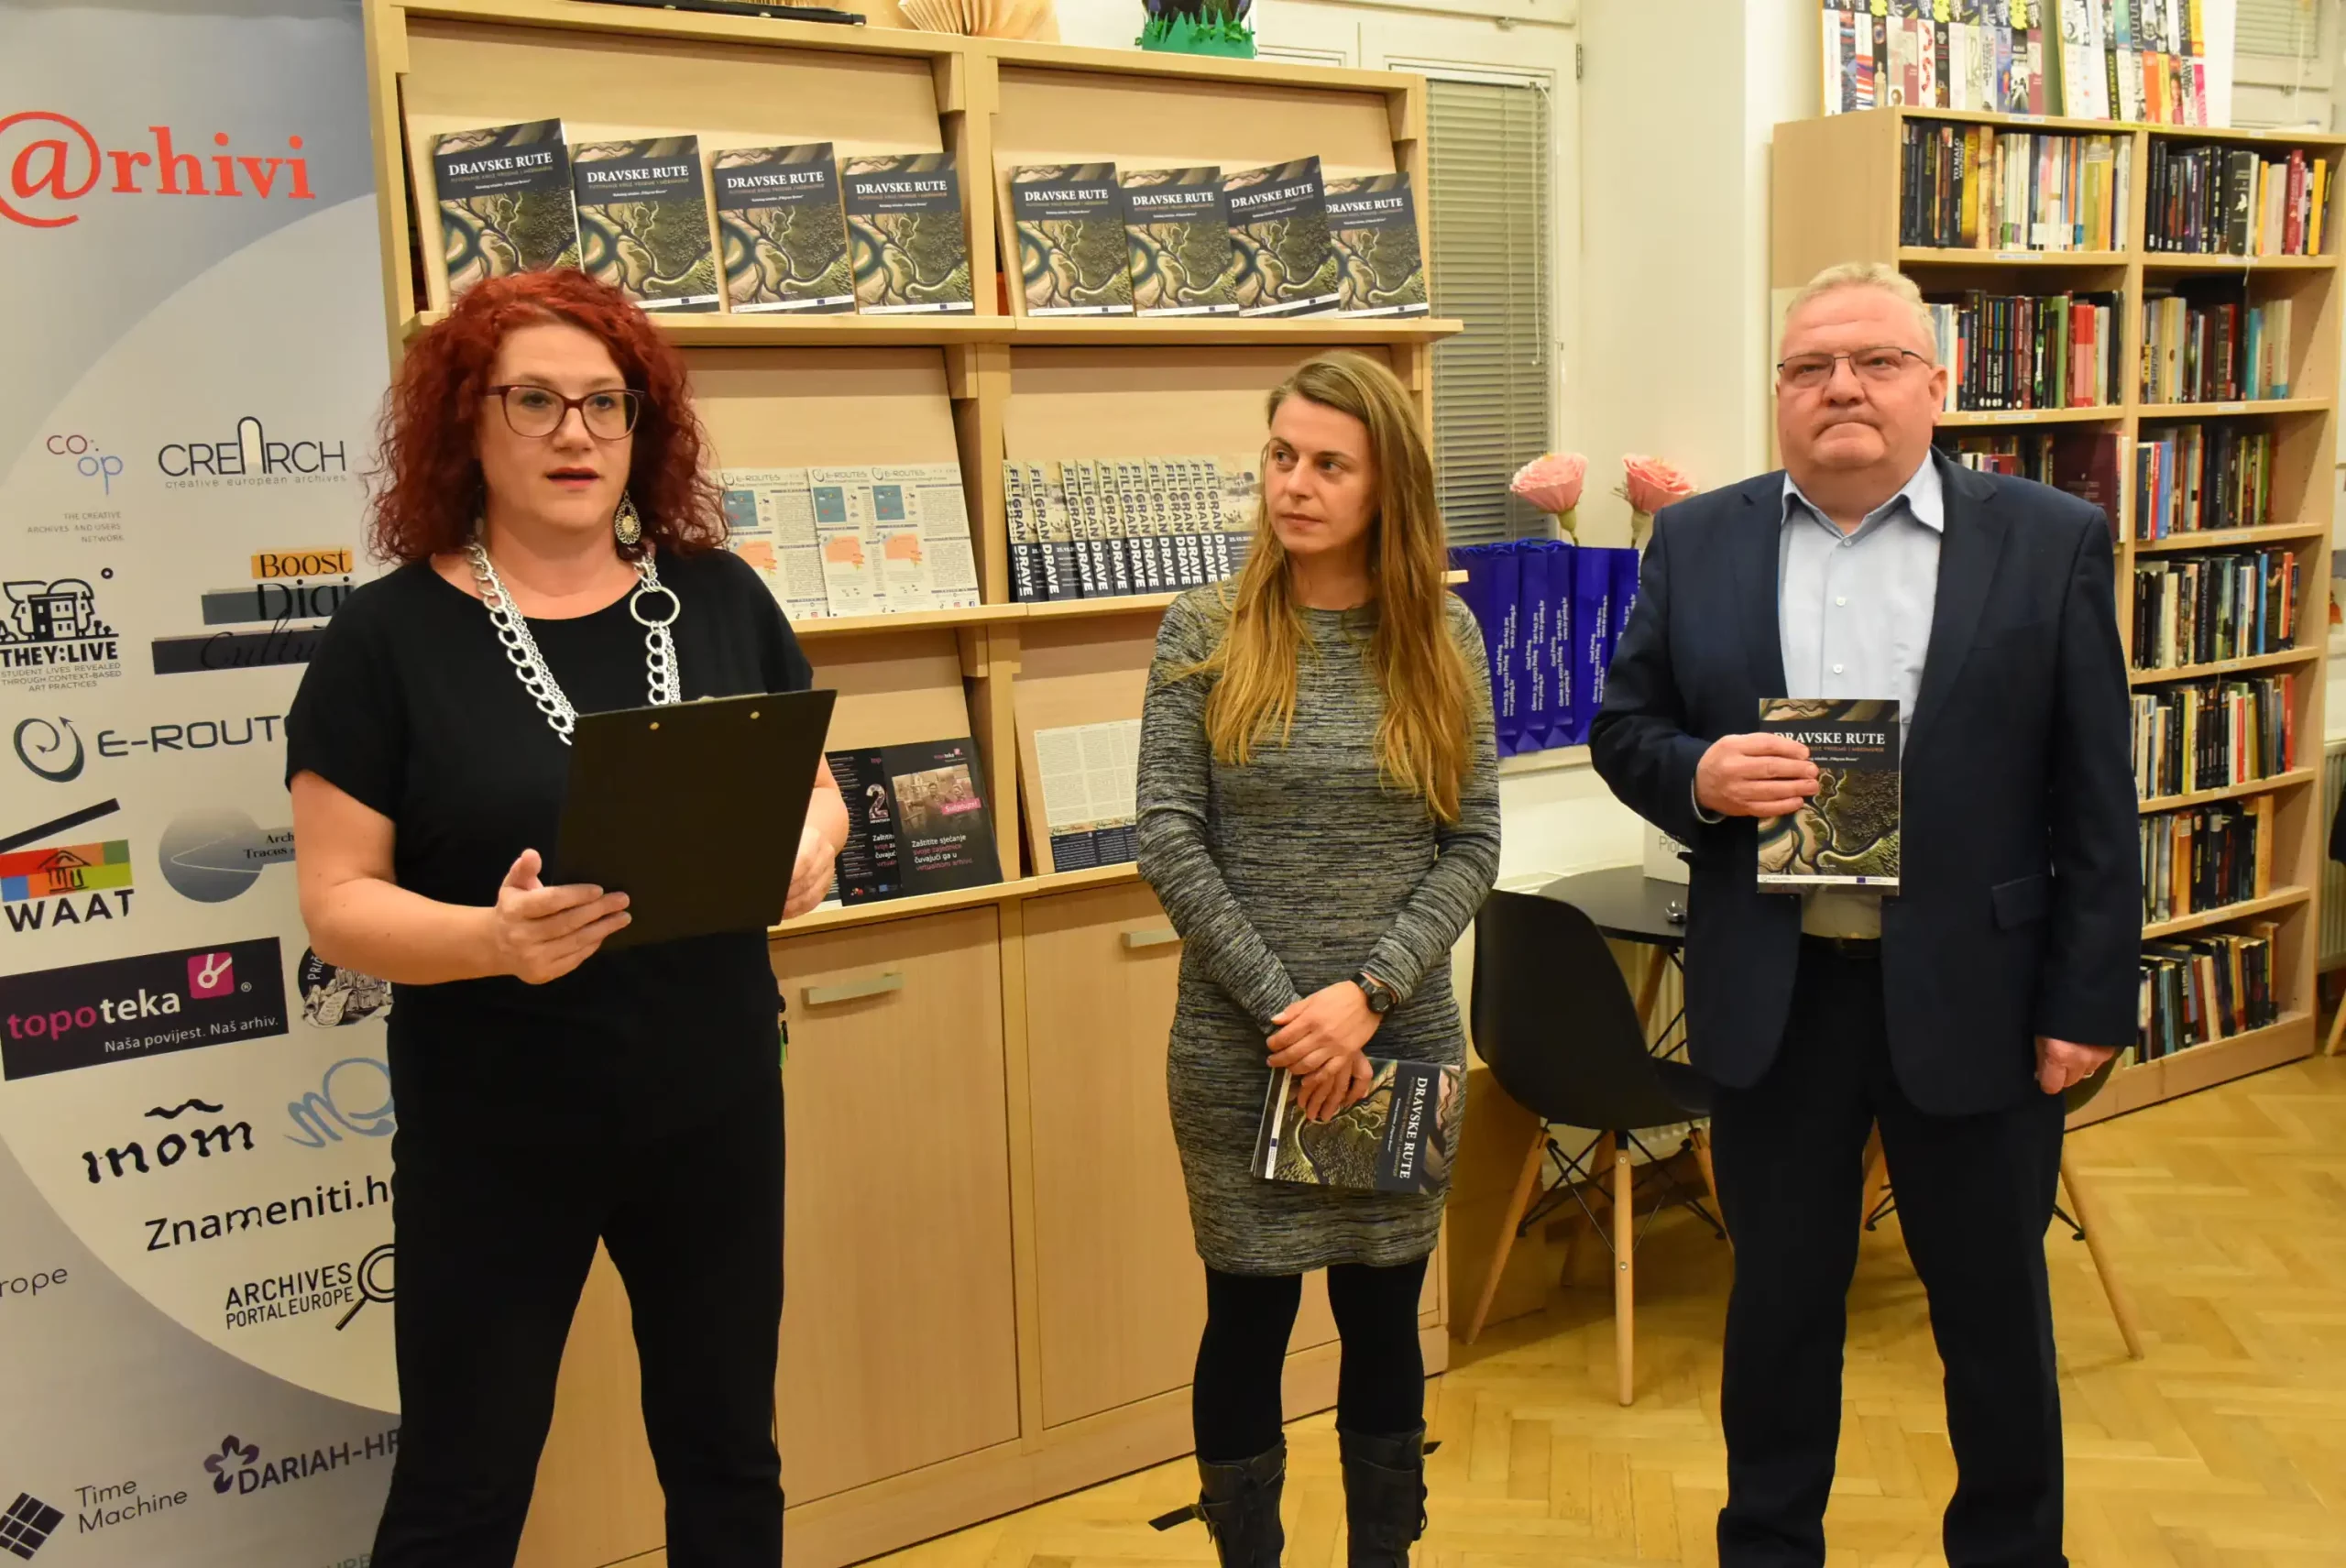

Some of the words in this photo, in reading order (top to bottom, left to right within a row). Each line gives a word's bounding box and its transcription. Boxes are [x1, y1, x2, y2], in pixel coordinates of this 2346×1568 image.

[448, 158, 513, 176] DRAVSKE
[516, 152, 553, 168] RUTE
[587, 169, 650, 182] DRAVSKE
[652, 165, 689, 178] RUTE
[727, 174, 787, 188] DRAVSKE
[789, 171, 824, 184] RUTE
[856, 181, 912, 194] DRAVSKE
[915, 181, 947, 192] RUTE
[1025, 191, 1076, 201] DRAVSKE
[1078, 189, 1109, 200] RUTE
[1133, 194, 1183, 205] DRAVSKE
[1184, 192, 1214, 203] RUTE
[1231, 190, 1283, 208] DRAVSKE
[1284, 183, 1314, 198] RUTE
[1374, 198, 1403, 209] RUTE
[166, 479, 219, 489] creative
[226, 477, 287, 487] european
[295, 474, 347, 483] archives
[64, 512, 80, 521] THE
[82, 511, 121, 520] CREATIVE
[1010, 469, 1025, 541] FILIGRAN
[1190, 464, 1210, 531] FILIGRAN
[1201, 535, 1217, 583] DRAVE
[1204, 464, 1222, 530] FILIGRAN
[1214, 534, 1231, 581] DRAVE
[27, 525, 70, 533] ARCHIVES
[81, 534, 125, 543] NETWORK
[1031, 469, 1049, 540] FILIGRAN
[1042, 544, 1059, 594] DRAVE
[1064, 468, 1083, 538] FILIGRAN
[1076, 543, 1093, 591] DRAVE
[1080, 467, 1100, 537] FILIGRAN
[1091, 542, 1108, 590] DRAVE
[1101, 467, 1119, 535] FILIGRAN
[1111, 541, 1127, 589] DRAVE
[1118, 466, 1136, 534] FILIGRAN
[1129, 539, 1146, 587] DRAVE
[1132, 466, 1150, 533] FILIGRAN
[1142, 538, 1159, 587] DRAVE
[1149, 466, 1168, 532] FILIGRAN
[1159, 537, 1175, 586] DRAVE
[1165, 465, 1183, 532] FILIGRAN
[1175, 536, 1190, 585] DRAVE
[1176, 465, 1194, 532] FILIGRAN
[1187, 536, 1202, 584] DRAVE
[260, 547, 352, 577] Boost
[1017, 545, 1033, 596] DRAVE
[0, 641, 118, 667] THEY:LIVE
[1, 669, 42, 678] STUDENT
[46, 666, 71, 674] LIVES
[74, 663, 120, 672] REVEALED
[2, 677, 46, 685] THROUGH
[49, 670, 122, 682] CONTEXT-BASED
[49, 680, 97, 690] PRACTICES
[98, 715, 289, 757] E-ROUT
[1846, 733, 1885, 744] RUTE
[939, 834, 966, 844] sjećanje
[5, 888, 135, 932] WAAT
[6, 988, 181, 1040] topoteka
[104, 1036, 140, 1053] Naša
[144, 1027, 206, 1048] povijest.
[211, 1020, 236, 1036] Naš
[240, 1014, 279, 1031] arhiv.
[1407, 1077, 1428, 1138] DRAVSKE
[1399, 1142, 1415, 1179] RUTE
[225, 1263, 352, 1310] ARCHIVES
[75, 1478, 137, 1508] Time
[78, 1489, 188, 1534] Machine
